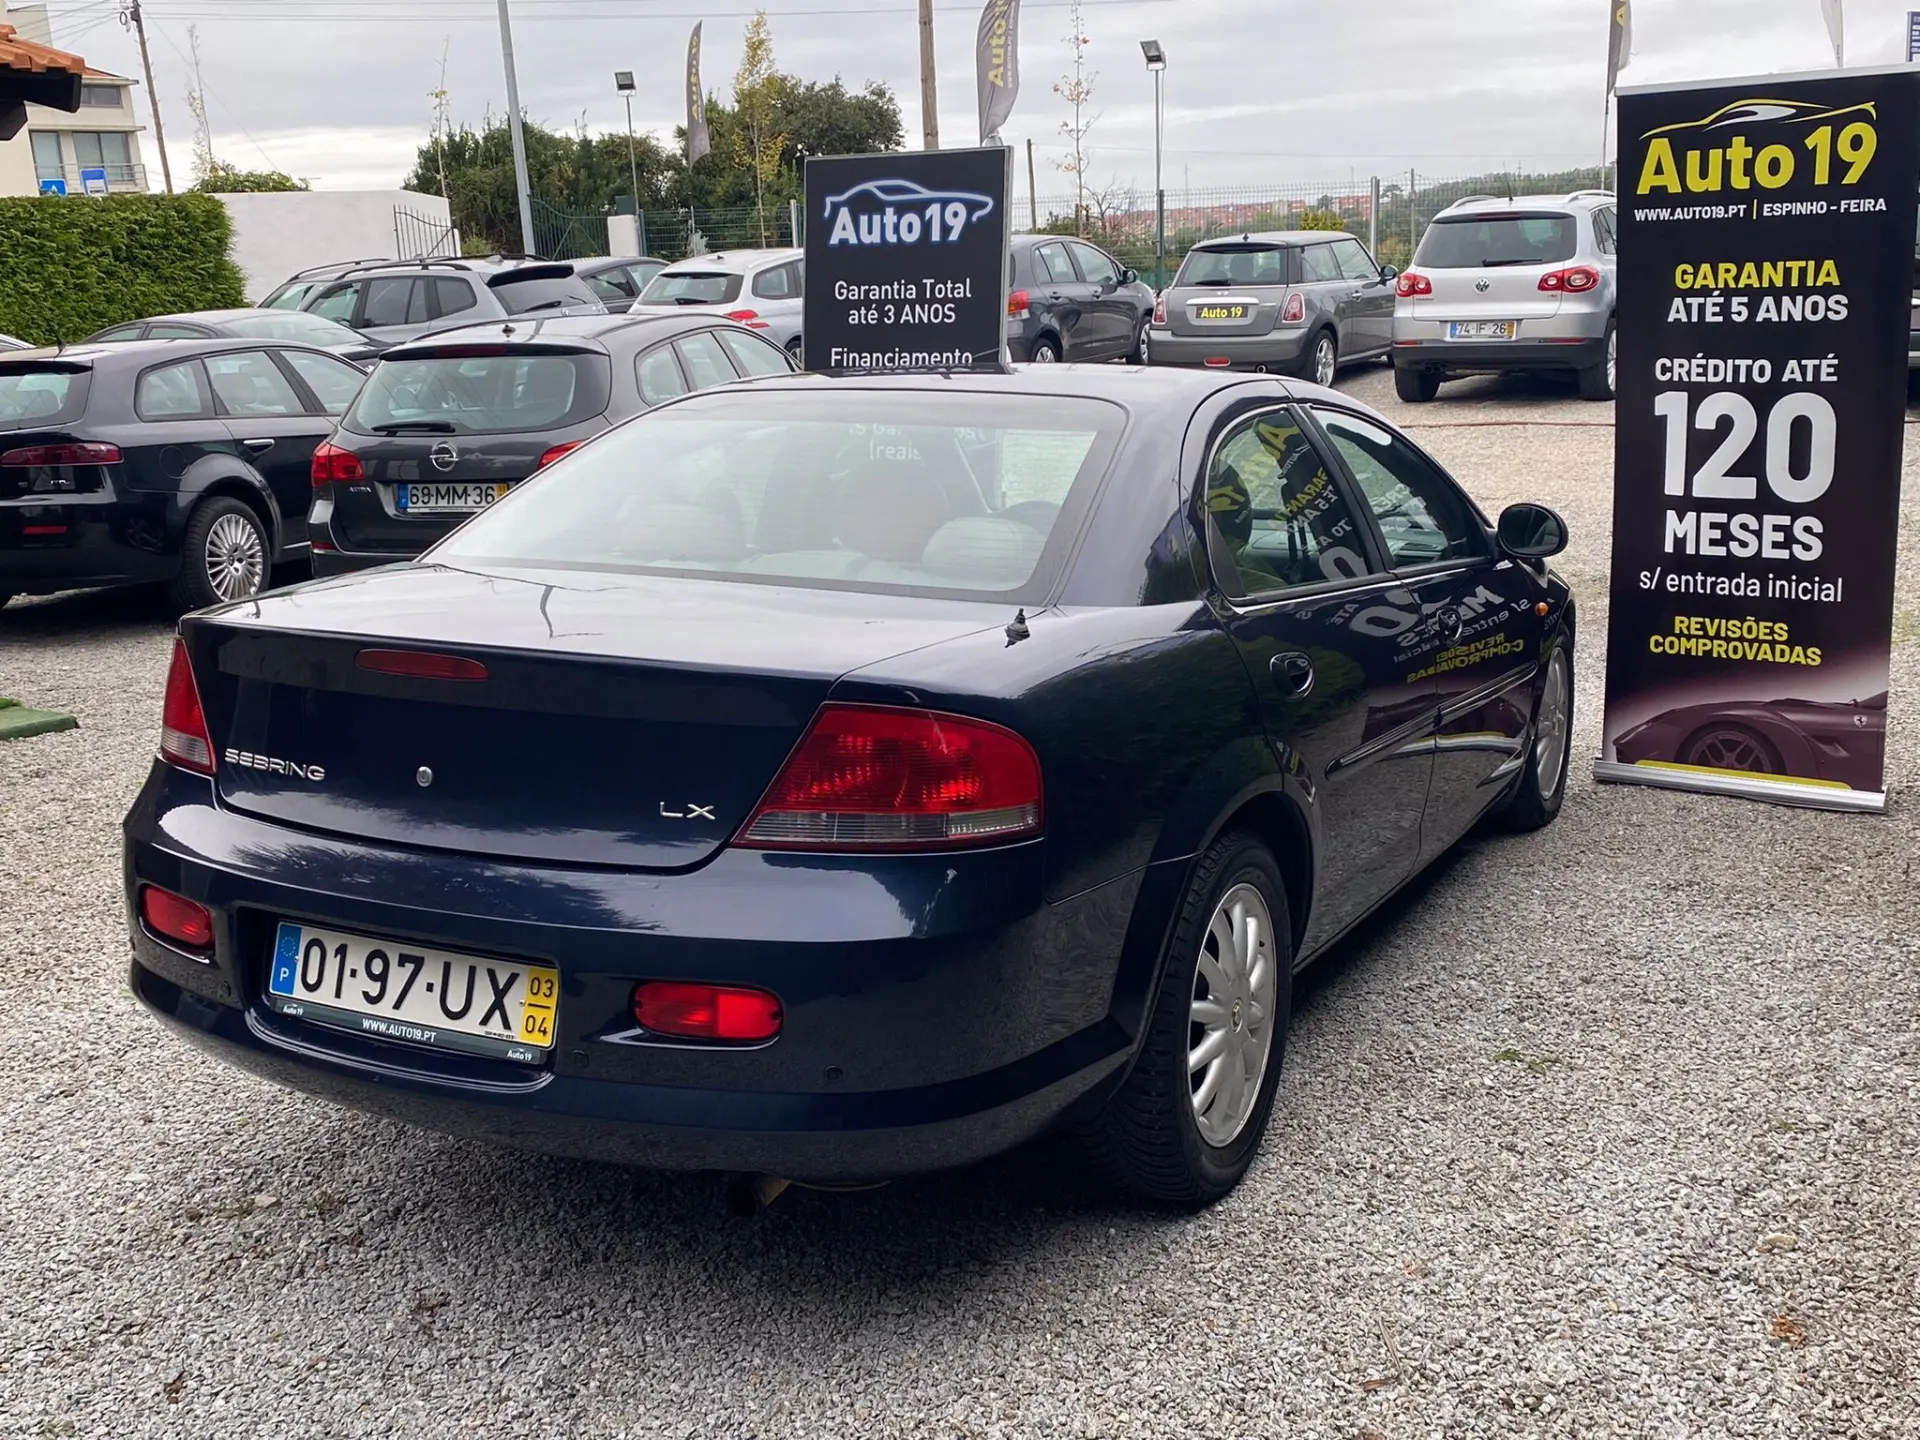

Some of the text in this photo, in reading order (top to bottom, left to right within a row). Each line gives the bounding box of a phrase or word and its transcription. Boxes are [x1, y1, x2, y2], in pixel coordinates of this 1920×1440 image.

[1634, 204, 1747, 221] WWW.AUTO19.PT
[1763, 201, 1827, 216] ESPINHO
[1840, 198, 1887, 213] FEIRA
[1675, 260, 1840, 289] GARANTIA
[834, 277, 972, 300] Garantia Total
[848, 303, 956, 324] até 3 ANOS
[1200, 306, 1243, 318] Auto 19
[1667, 290, 1848, 322] ATÉ 5 ANOS
[830, 347, 972, 368] Financiamento
[1655, 353, 1839, 383] CRÉDITO ATÉ
[1655, 391, 1837, 503] 120
[1664, 510, 1823, 561] MESES
[1639, 567, 1843, 602] s/ entrada inicial
[1674, 616, 1789, 642] REVISÕES
[1650, 635, 1822, 666] COMPROVADAS
[224, 748, 325, 782] SEBRING
[660, 801, 716, 820] LX
[279, 967, 289, 982] P
[529, 976, 554, 998] 03
[362, 1018, 437, 1042] WWW.AUTO19.PT
[524, 1014, 549, 1037] 04
